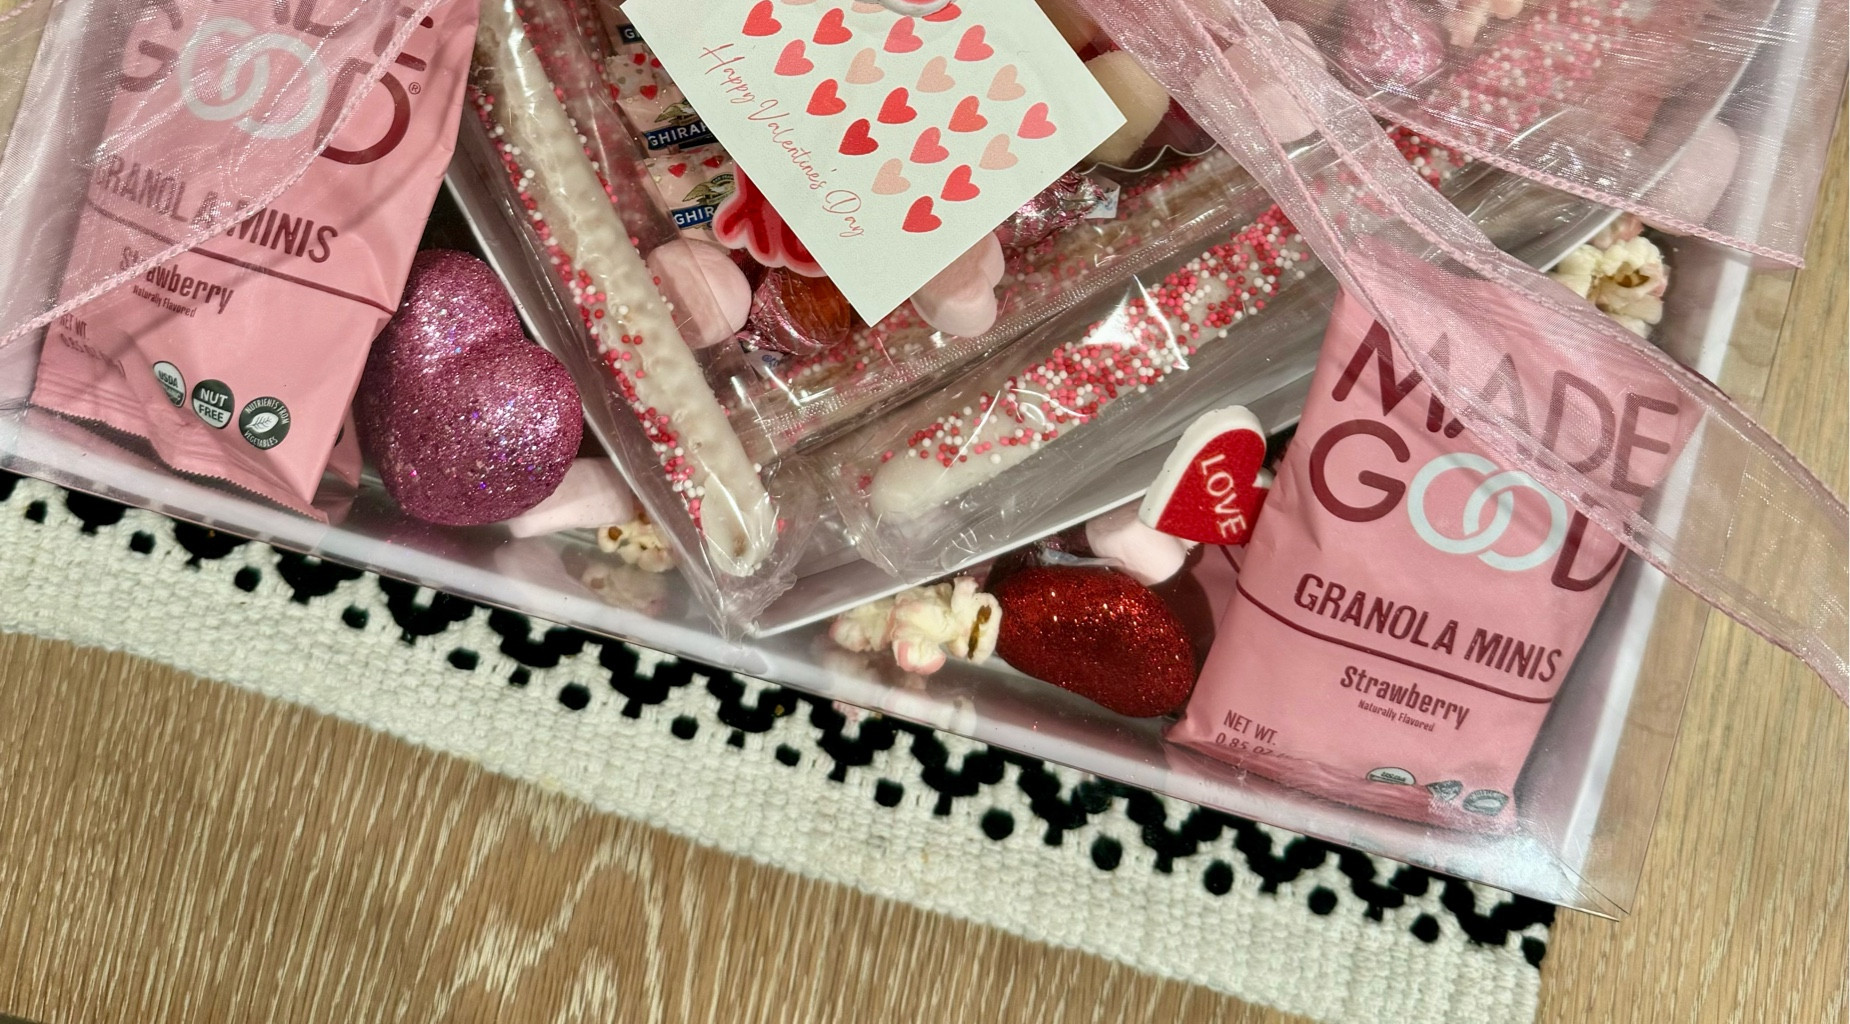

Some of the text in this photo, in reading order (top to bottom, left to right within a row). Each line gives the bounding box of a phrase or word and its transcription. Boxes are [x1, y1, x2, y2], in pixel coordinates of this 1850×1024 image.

[699, 43, 865, 238] Happy Valentine's Day
[227, 199, 339, 263] MINIS
[120, 246, 235, 315] Stawberry
[132, 284, 198, 318] Naturally Flavored
[158, 370, 179, 388] USDA
[200, 387, 228, 407] NUT
[198, 403, 225, 424] FREE
[246, 397, 290, 426] NUTRIENTS FROM
[1331, 318, 1679, 498] MADE
[243, 429, 278, 448] VEGETABLES
[1201, 454, 1247, 538] LOVE
[1309, 419, 1638, 592] GOOD
[1294, 572, 1562, 683] GRANOLA MINIS
[1340, 665, 1470, 730] Strawberry
[1357, 698, 1434, 733] Naturally Flavored
[1223, 709, 1279, 746] NET WT.
